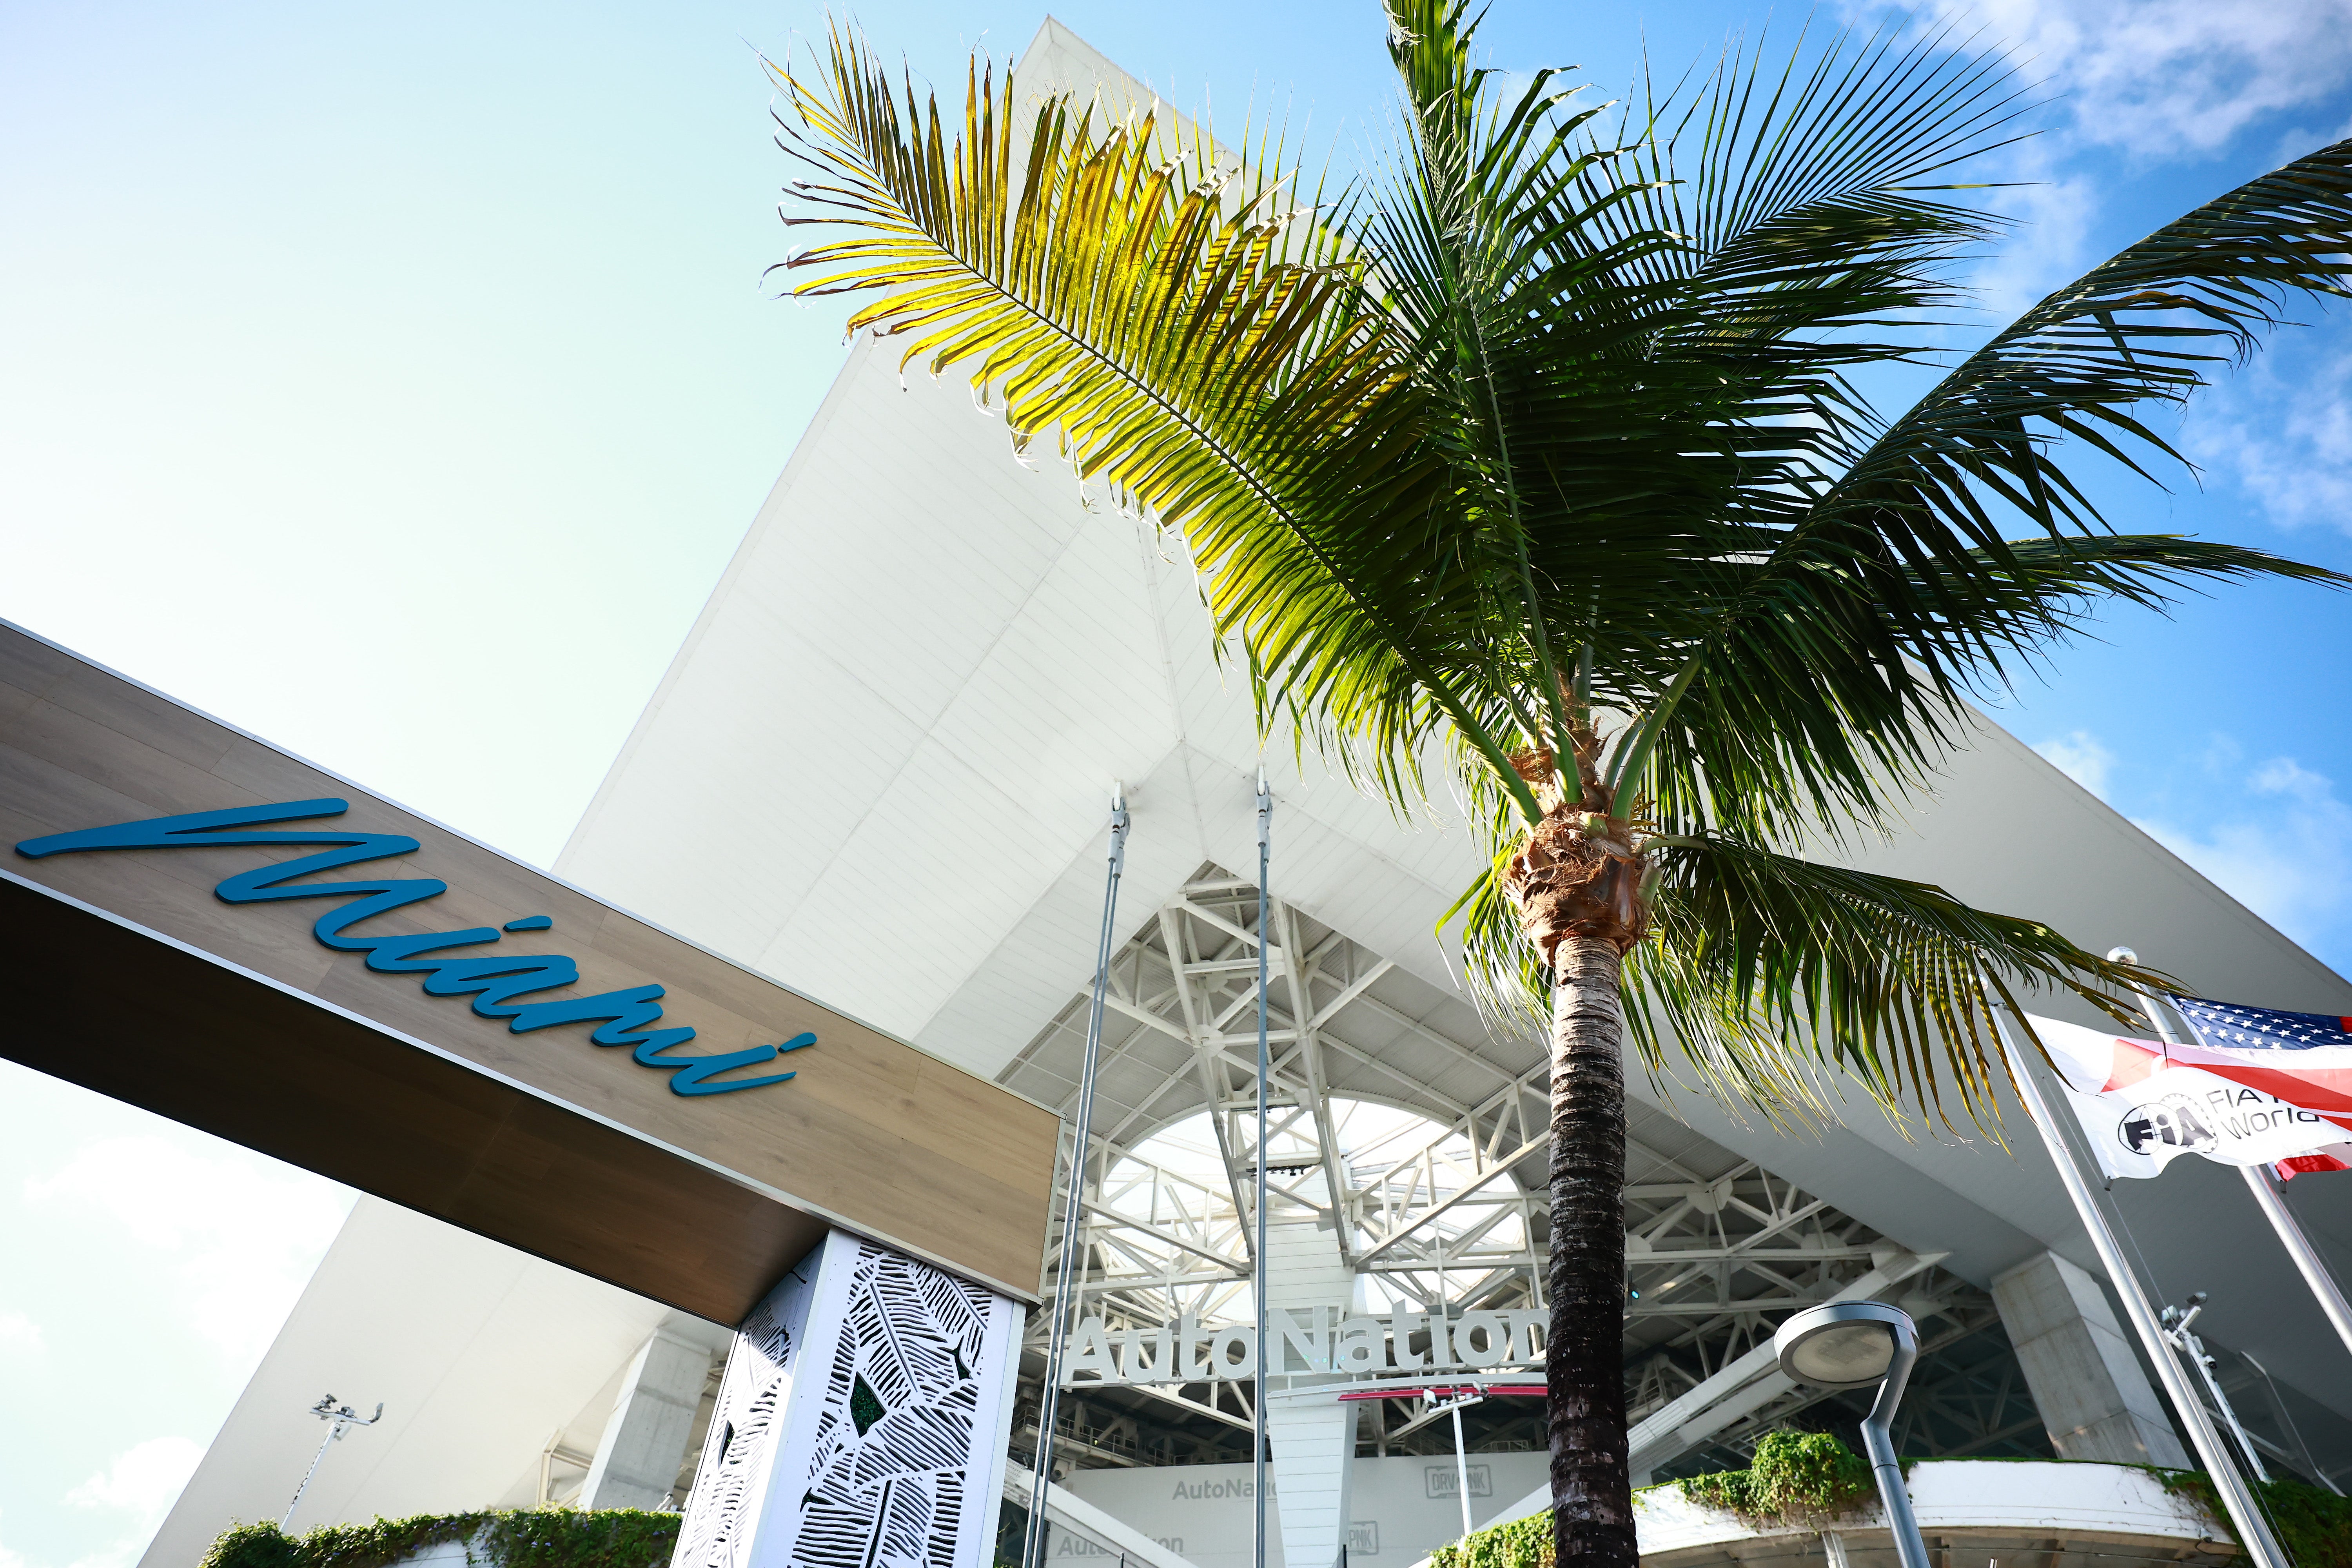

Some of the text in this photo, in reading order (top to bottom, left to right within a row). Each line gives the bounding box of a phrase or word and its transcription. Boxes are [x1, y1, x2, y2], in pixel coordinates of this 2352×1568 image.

[15, 797, 817, 1097] Miami
[2206, 1089, 2263, 1114] FIA
[1060, 1298, 1550, 1386] AutoNation
[1432, 1473, 1455, 1490] DRV
